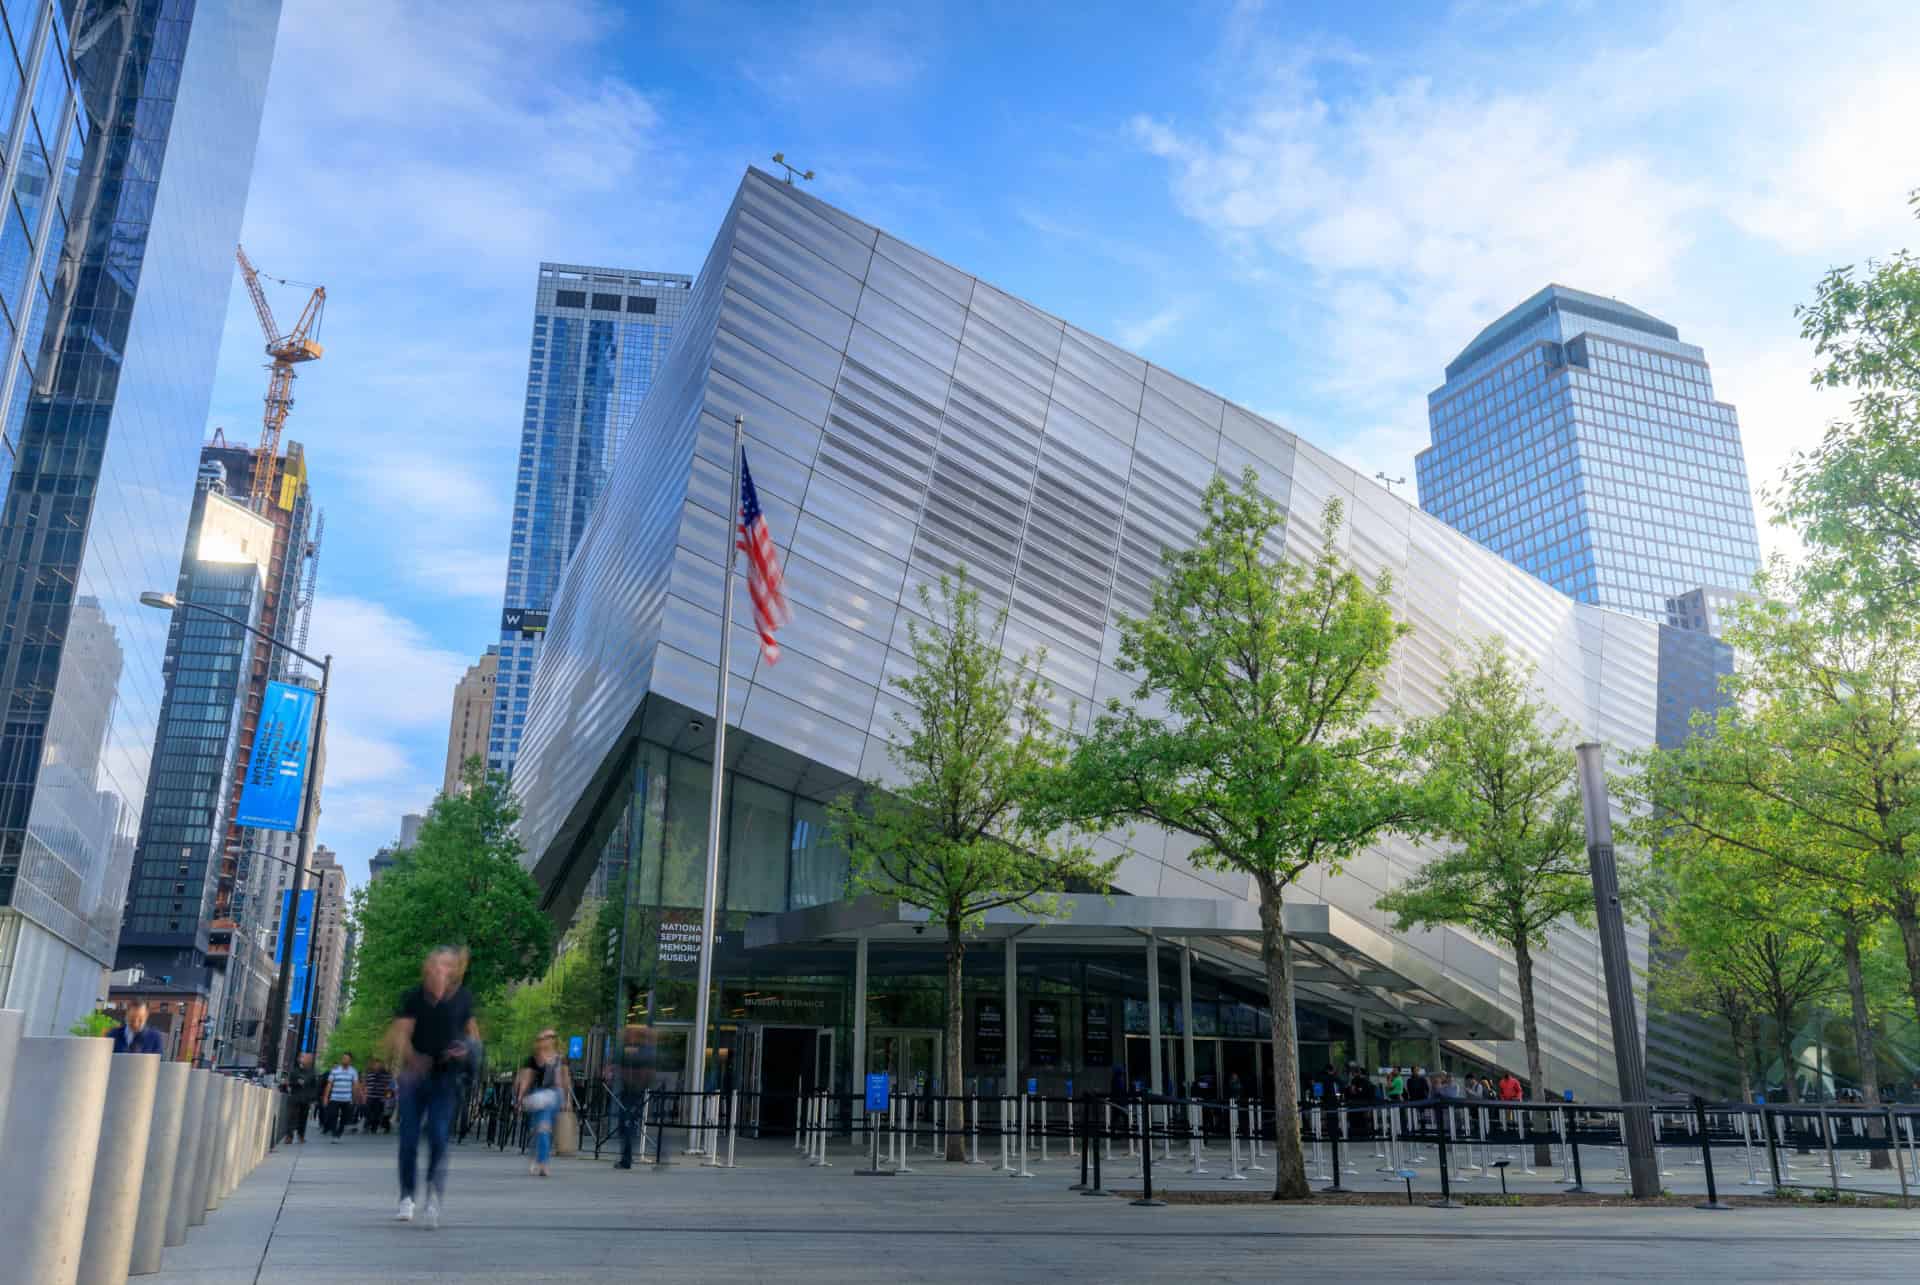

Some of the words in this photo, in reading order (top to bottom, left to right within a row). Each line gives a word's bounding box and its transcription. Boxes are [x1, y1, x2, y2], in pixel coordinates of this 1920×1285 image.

[506, 615, 521, 625] W
[250, 732, 269, 785] MUSEUM
[660, 923, 702, 932] NATIONA
[660, 933, 702, 943] SEPTEMB
[659, 943, 701, 952] MEMORIA
[658, 953, 697, 963] MUSEUM
